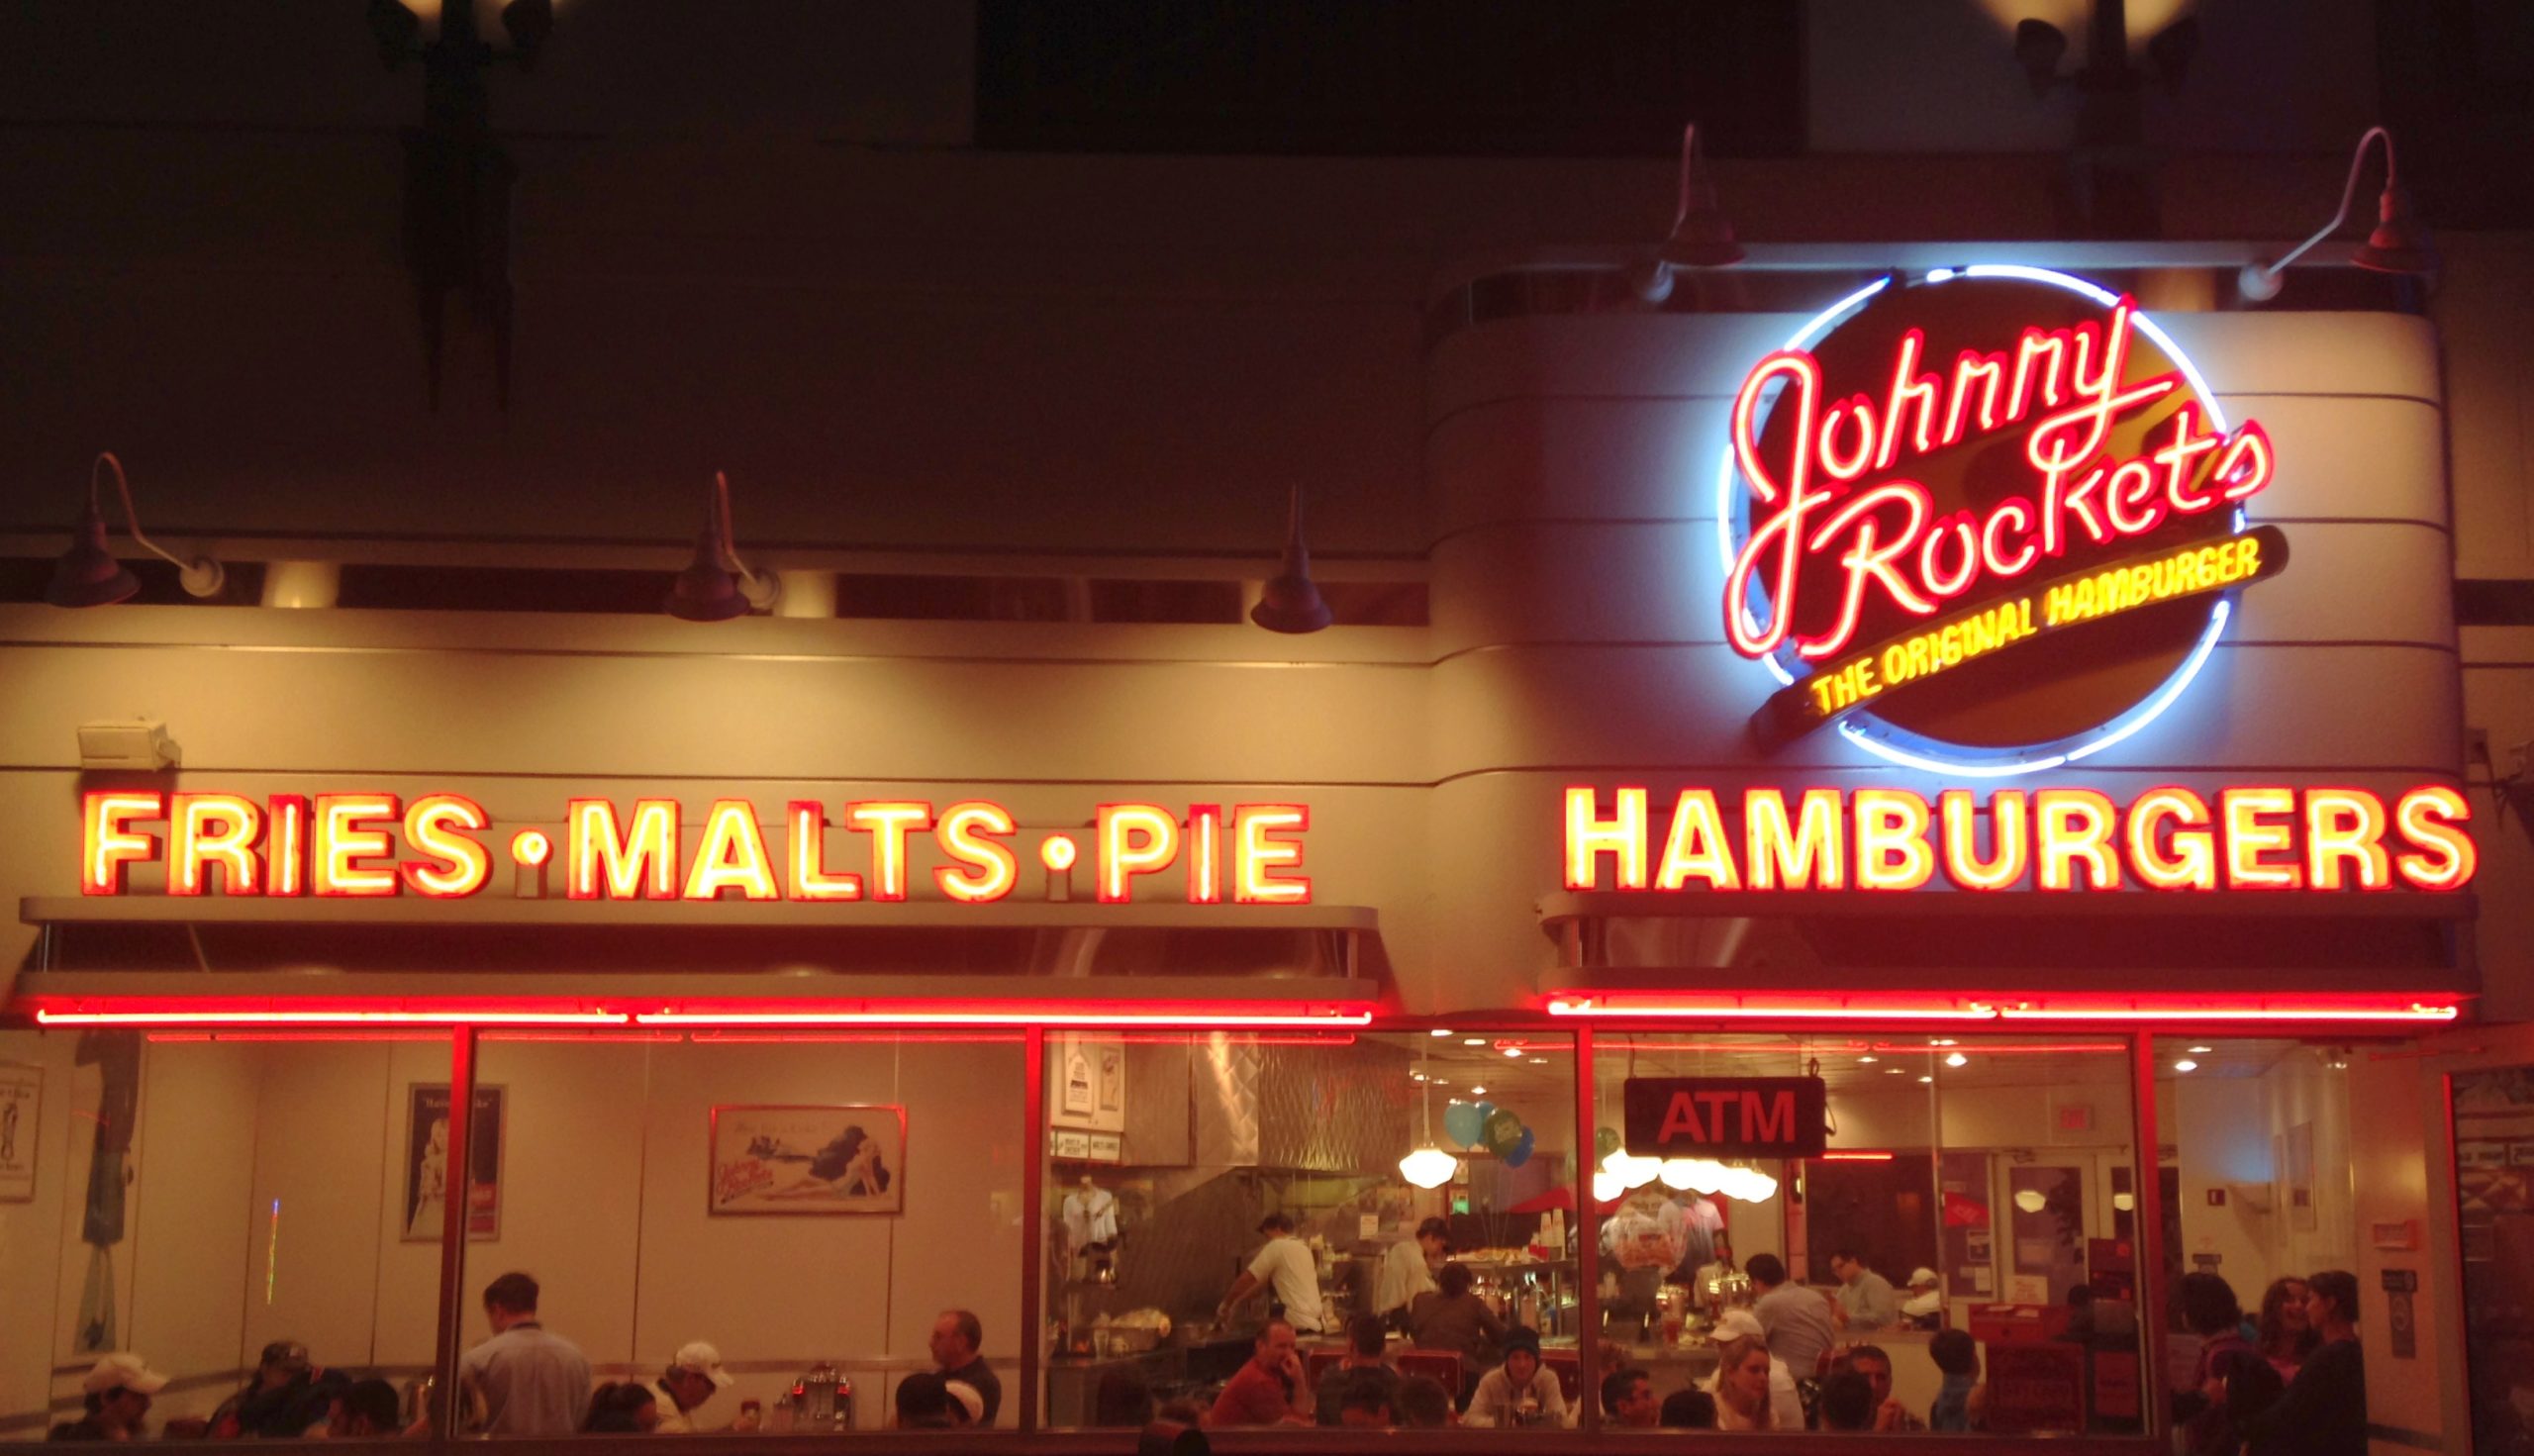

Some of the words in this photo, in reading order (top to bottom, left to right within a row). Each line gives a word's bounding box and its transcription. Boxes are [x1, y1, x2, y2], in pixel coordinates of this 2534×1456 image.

[1724, 292, 2184, 661] Johnny
[1798, 399, 2276, 659] Rockets
[1811, 666, 1882, 715] THE
[1882, 599, 2038, 688] ORIGINAL
[2046, 536, 2262, 627] HAMBURGER
[81, 791, 492, 896] FRIES
[567, 798, 1019, 904] MALTS
[1095, 803, 1311, 904] PIE
[1561, 785, 2480, 892] HAMBURGERS
[1657, 1091, 1796, 1143] ATM
